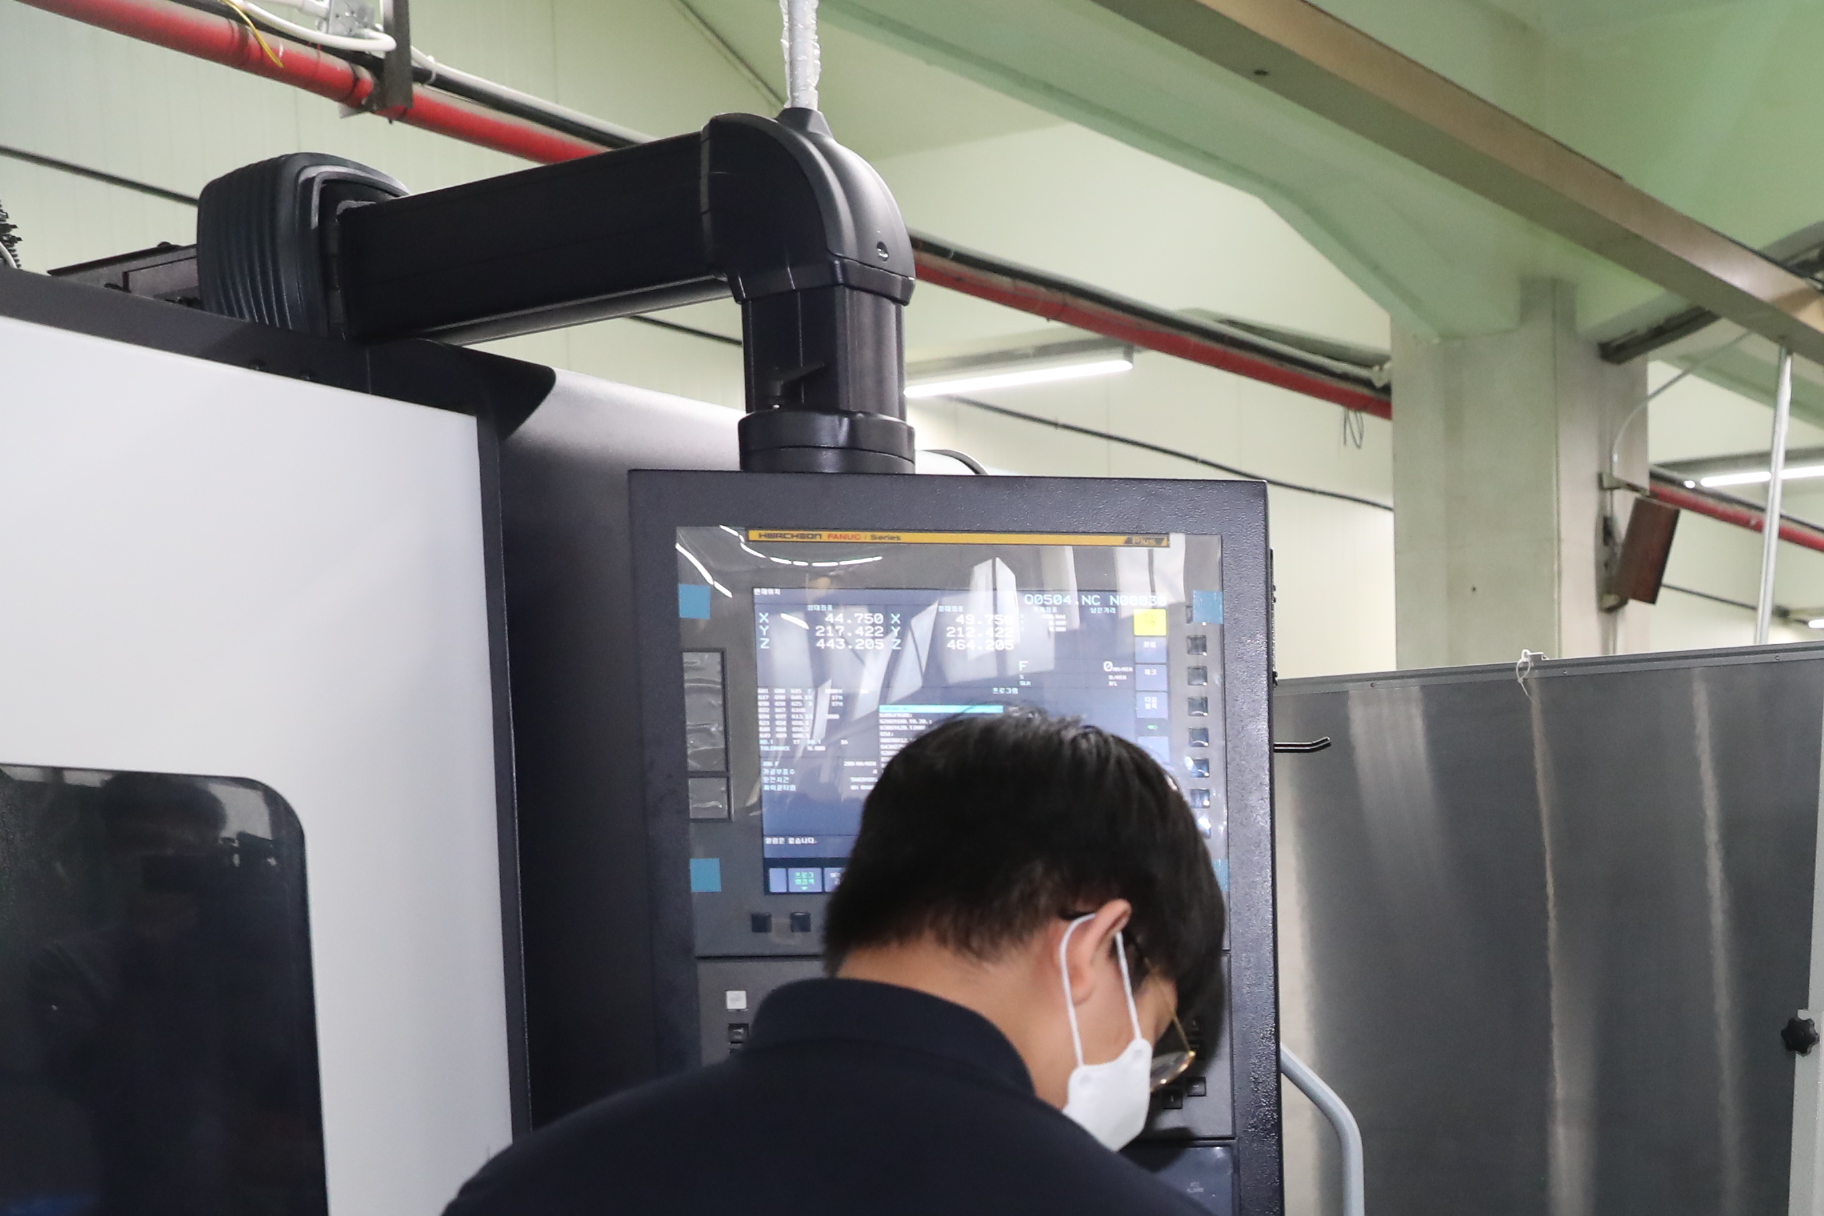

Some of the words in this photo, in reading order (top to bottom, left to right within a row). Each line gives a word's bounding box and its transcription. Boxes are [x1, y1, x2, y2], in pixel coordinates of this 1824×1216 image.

[827, 533, 862, 541] FANUC
[870, 533, 902, 542] Series
[759, 613, 769, 624] X
[825, 613, 884, 624] 44.750
[891, 614, 901, 625] X
[759, 625, 769, 636] Y
[815, 626, 884, 637] 217.422
[891, 626, 901, 637] Y
[760, 638, 770, 649] Z
[816, 638, 885, 650] 443.205
[892, 639, 902, 650] Z
[947, 639, 1014, 651] 464.205
